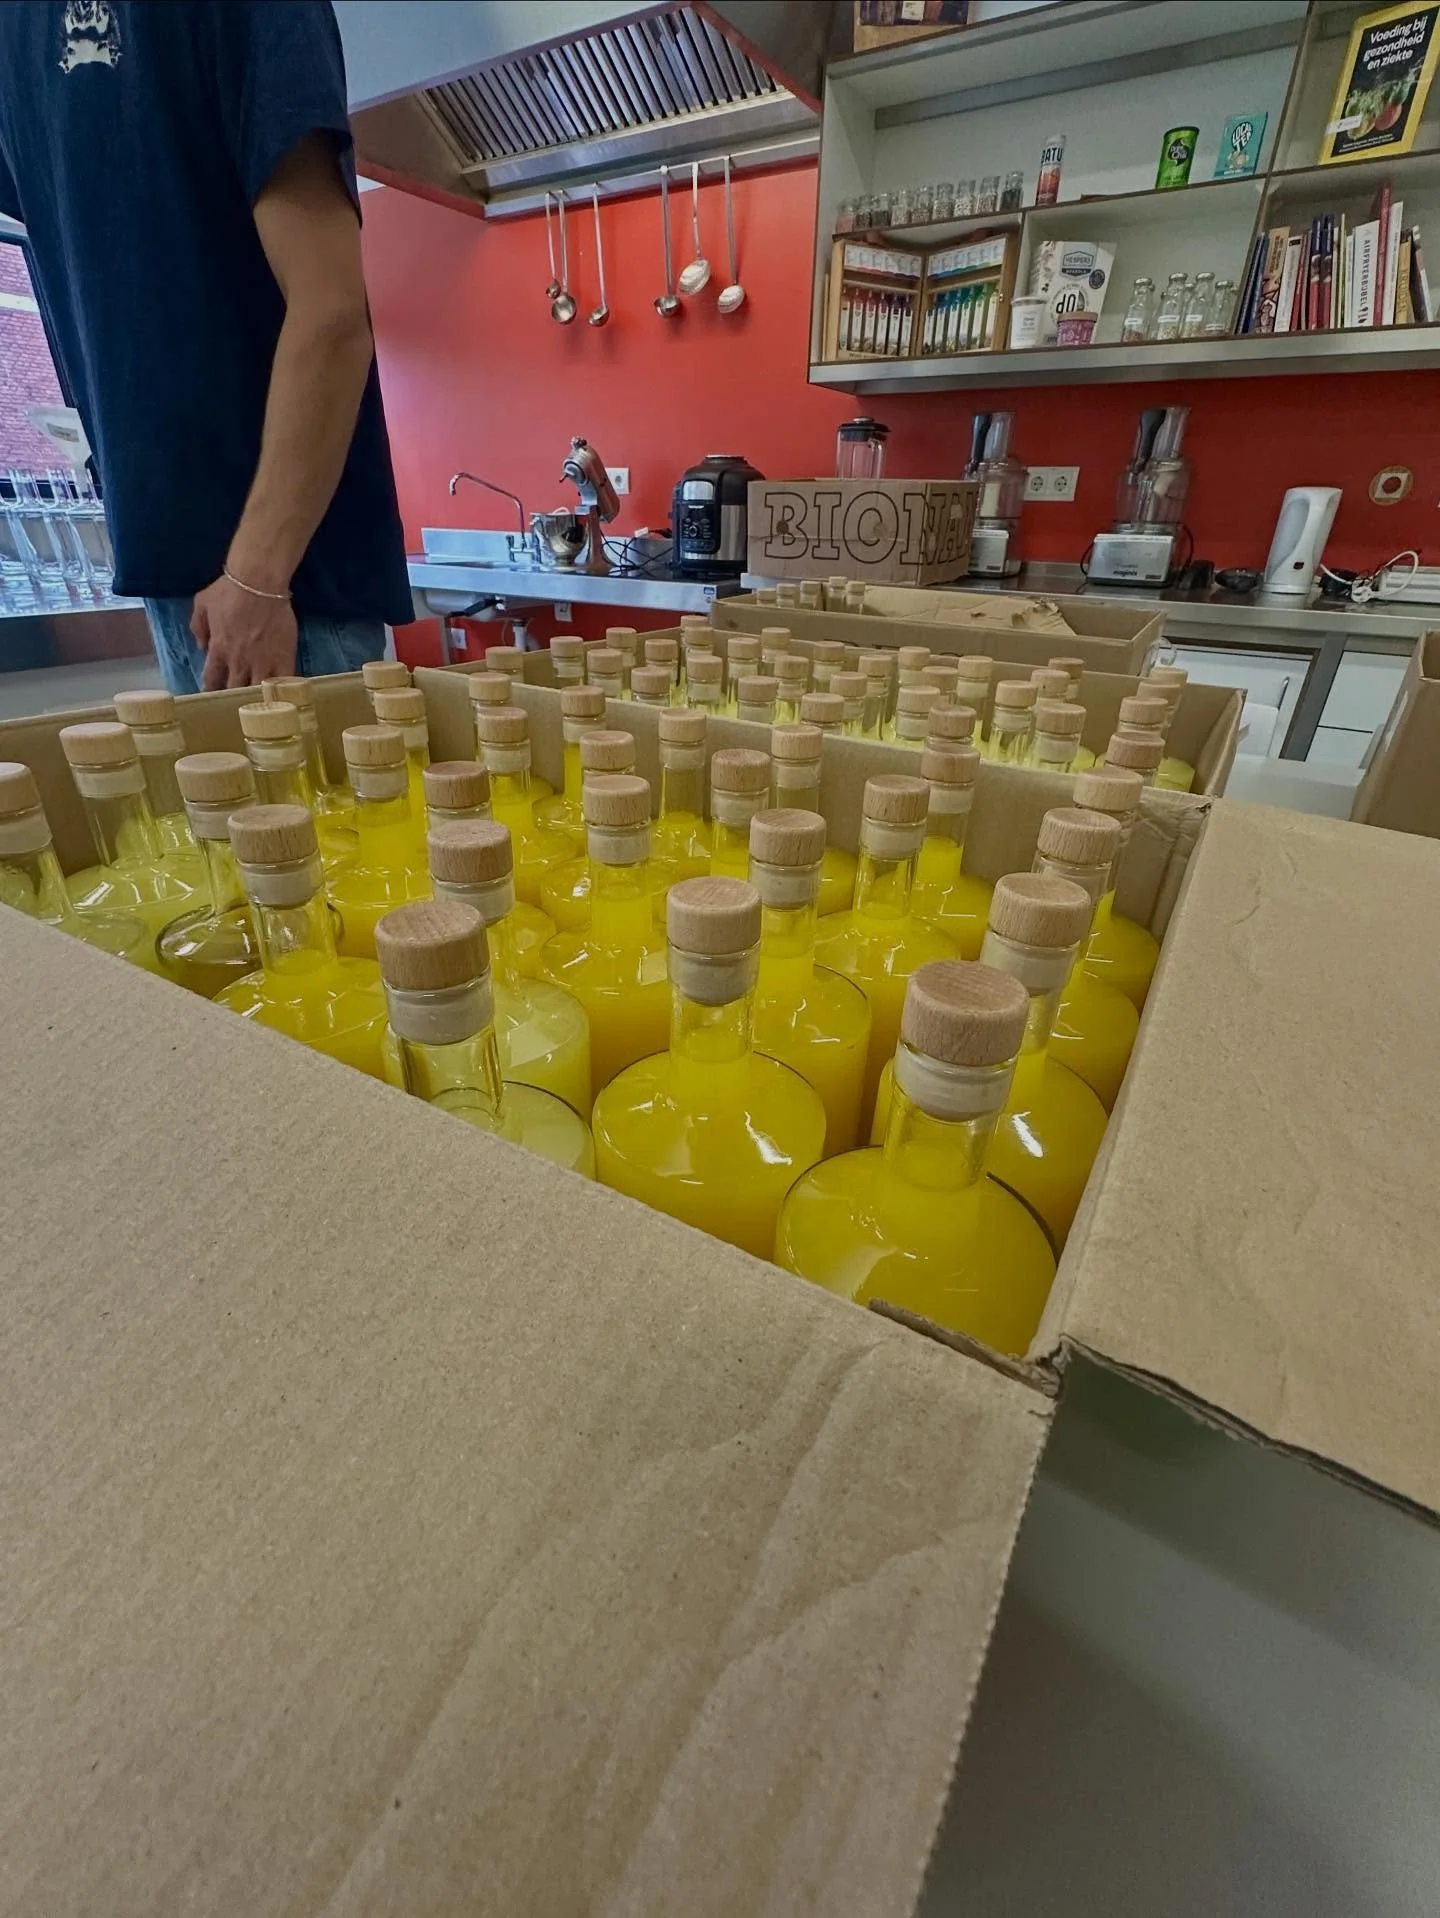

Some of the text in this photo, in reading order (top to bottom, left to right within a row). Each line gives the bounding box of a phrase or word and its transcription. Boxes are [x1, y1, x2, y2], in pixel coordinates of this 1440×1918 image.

[1370, 15, 1428, 44] Voeding bij
[1363, 31, 1425, 62] gezondheid
[1367, 49, 1413, 71] en ziekte
[1232, 122, 1252, 143] LOCAL
